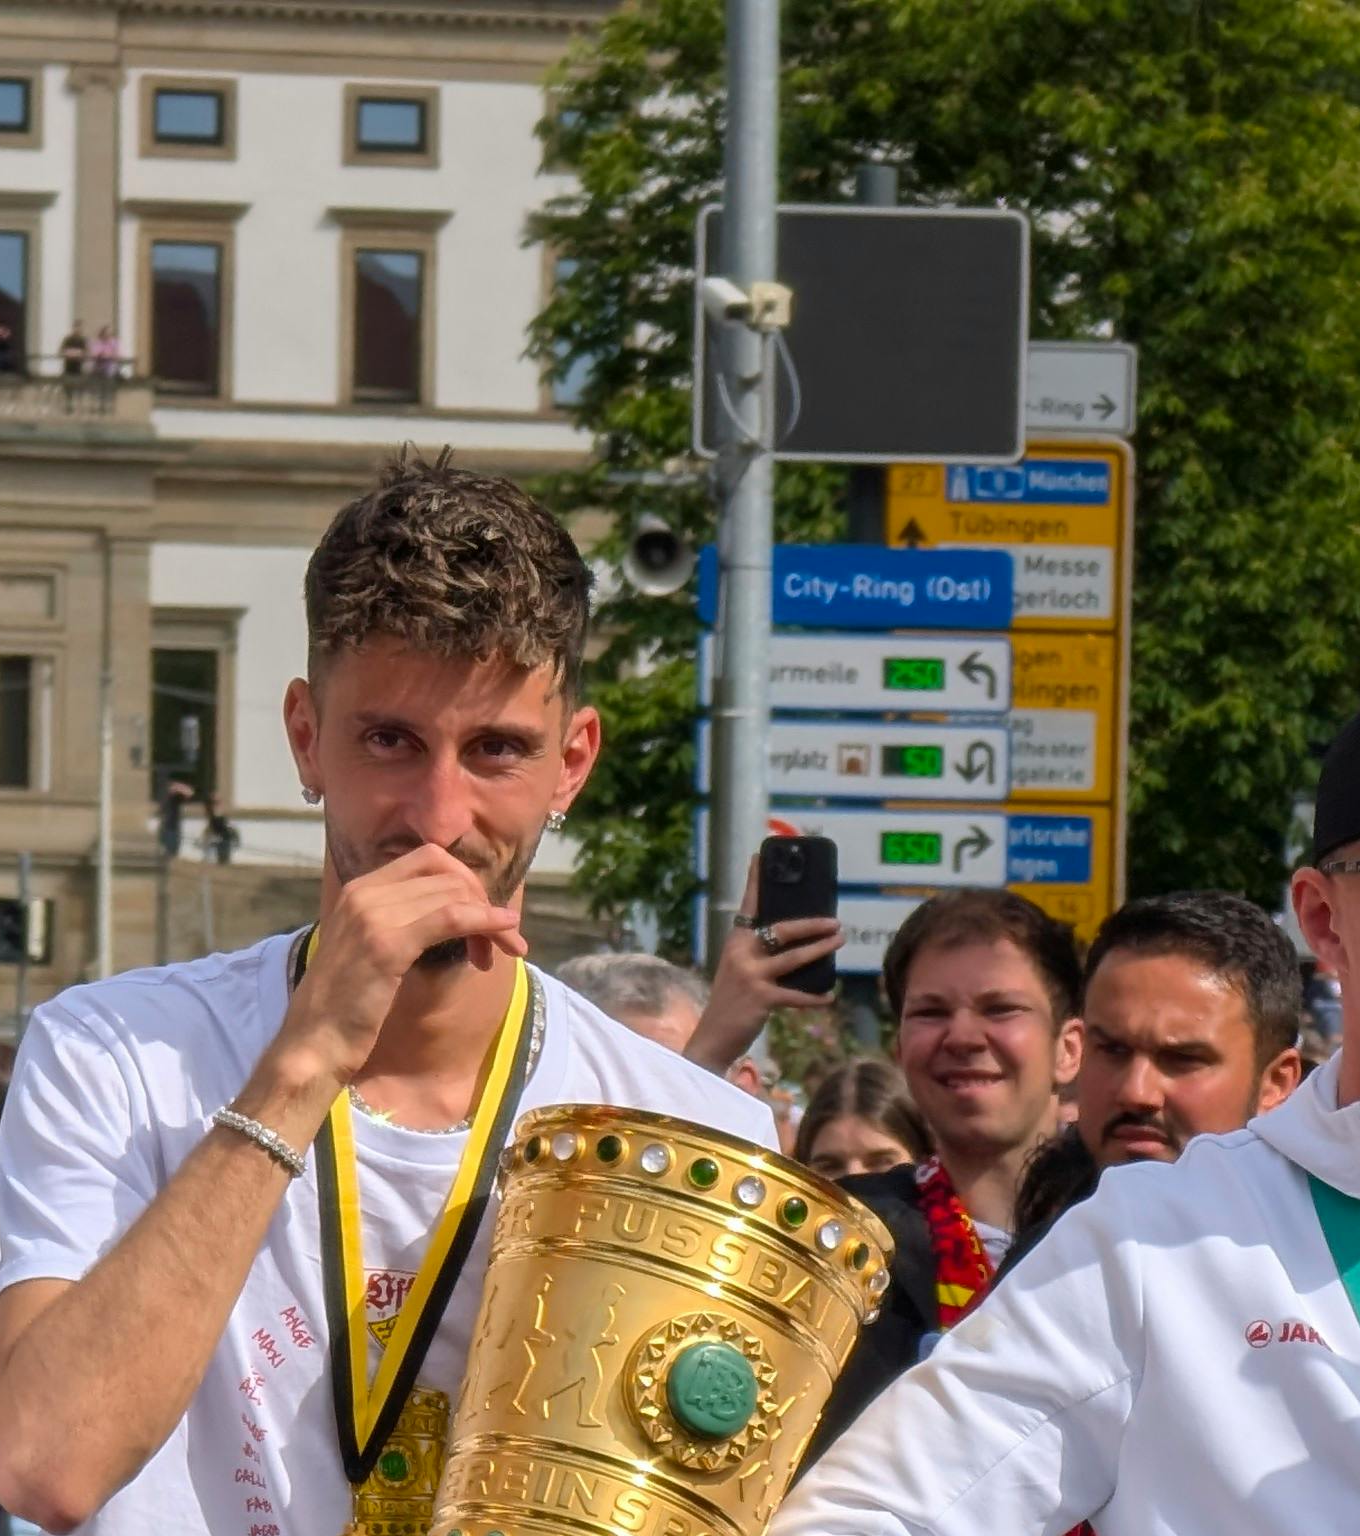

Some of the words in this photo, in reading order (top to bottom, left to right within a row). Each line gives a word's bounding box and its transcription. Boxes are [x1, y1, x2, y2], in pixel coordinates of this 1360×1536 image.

[1025, 397, 1085, 421] -Ring
[950, 510, 1070, 542] Tübingen
[1024, 555, 1101, 577] Messe
[783, 572, 916, 606] City-Ring
[926, 575, 991, 602] (Ost)
[279, 1305, 316, 1349] ANGE
[1278, 1321, 1334, 1353] JAK
[251, 1327, 286, 1369] MAXI
